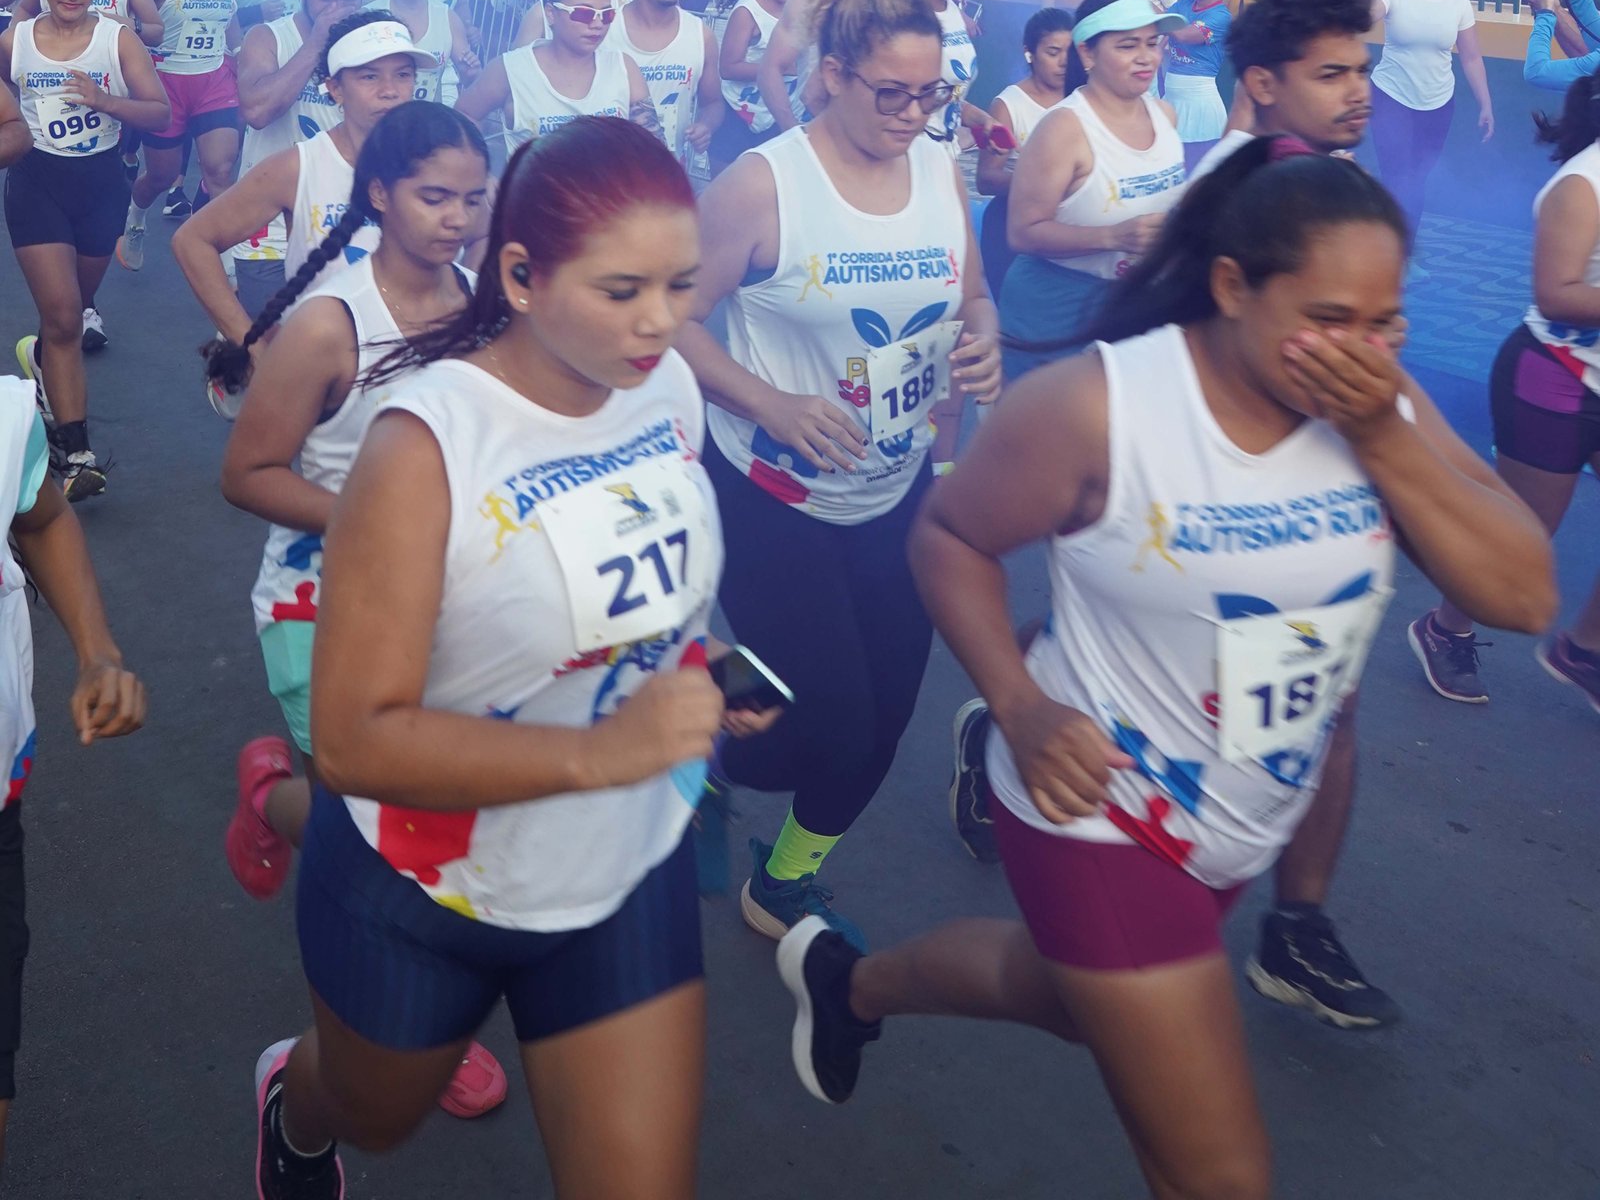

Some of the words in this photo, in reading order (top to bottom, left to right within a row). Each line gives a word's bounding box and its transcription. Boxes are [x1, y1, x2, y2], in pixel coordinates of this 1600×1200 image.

[182, 2, 219, 10] AUTISMO
[185, 36, 214, 50] 193
[666, 71, 687, 81] RUN
[48, 110, 101, 139] 096
[839, 251, 894, 264] CORRIDA
[895, 246, 947, 262] SOLIDÁRIA
[823, 263, 914, 285] AUTISMO
[919, 259, 951, 280] RUN
[881, 363, 935, 420] 188
[514, 451, 635, 522] AUTISMO
[1168, 515, 1320, 553] AUTISMO
[596, 528, 688, 619] 217
